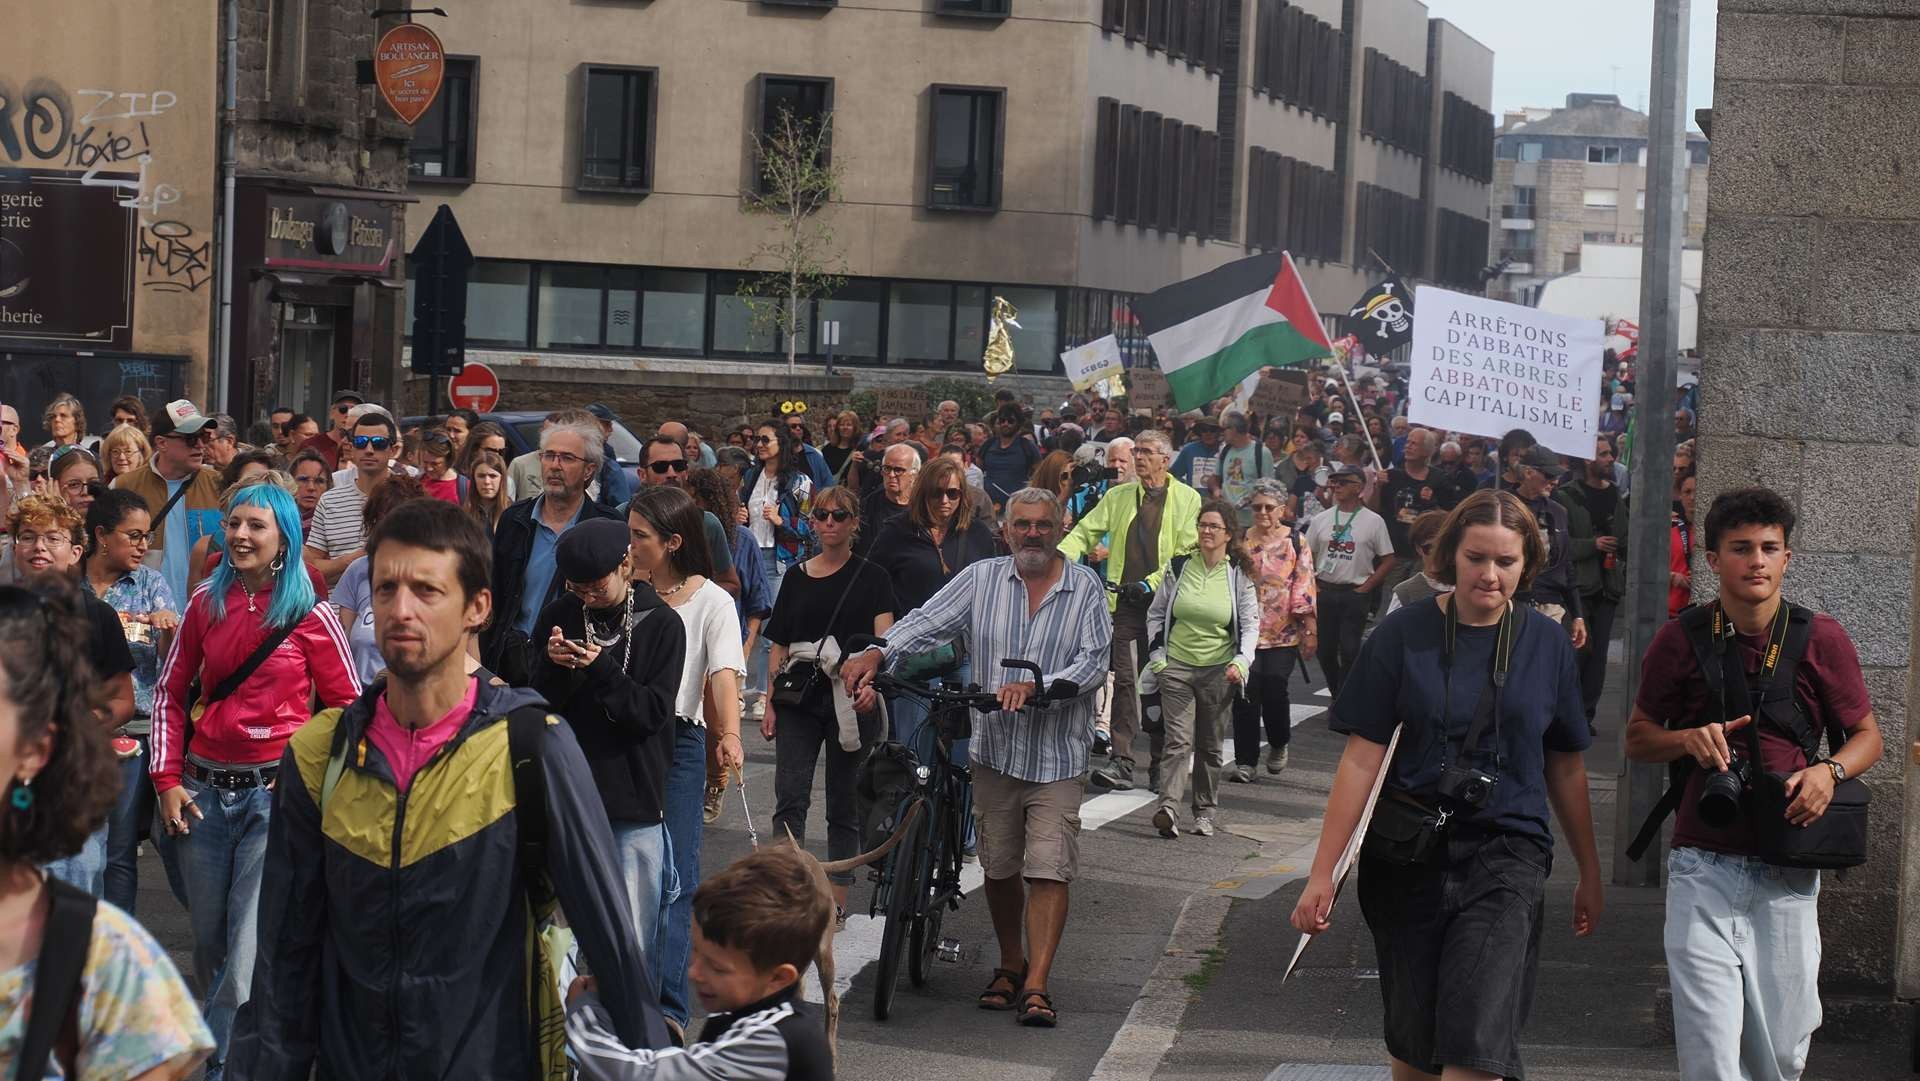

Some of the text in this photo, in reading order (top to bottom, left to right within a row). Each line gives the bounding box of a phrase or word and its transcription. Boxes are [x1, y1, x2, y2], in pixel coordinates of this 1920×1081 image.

[380, 51, 439, 61] BOULANGER
[390, 42, 430, 52] ARTISAN
[78, 88, 177, 124] ZIP
[1449, 310, 1567, 348] ARRÊTONS
[1447, 329, 1568, 368] D'ABBATRE
[1432, 346, 1582, 391] DES ARBRES !
[1430, 367, 1583, 412] ABBATONS LE
[1424, 385, 1588, 433] CAPITALISME !
[1765, 644, 1779, 669] Nikon
